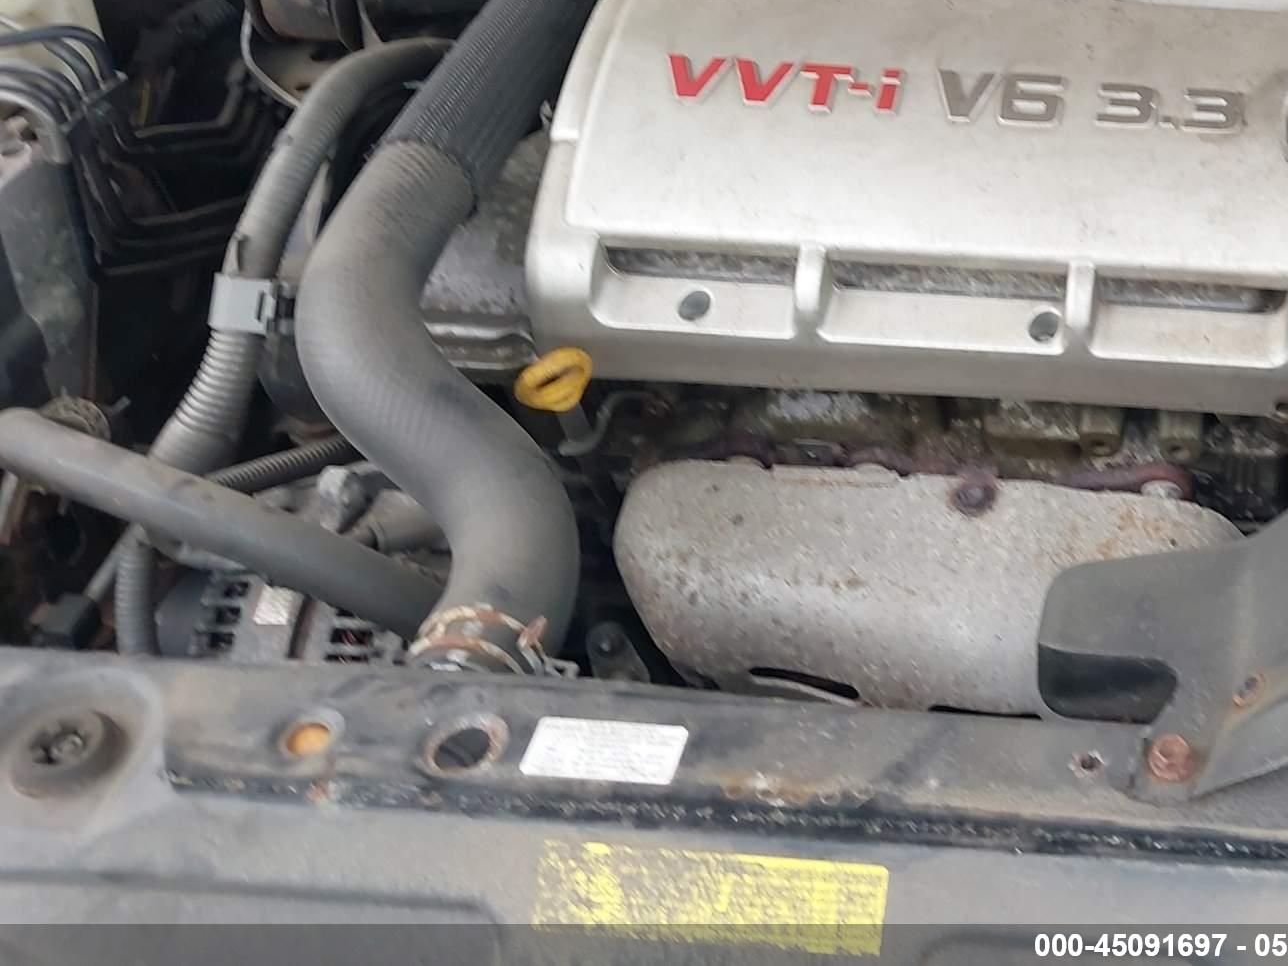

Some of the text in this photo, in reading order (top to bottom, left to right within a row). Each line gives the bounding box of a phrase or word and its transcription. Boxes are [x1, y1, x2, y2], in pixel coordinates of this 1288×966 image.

[666, 53, 1248, 134] VVT-i V6 3.3
